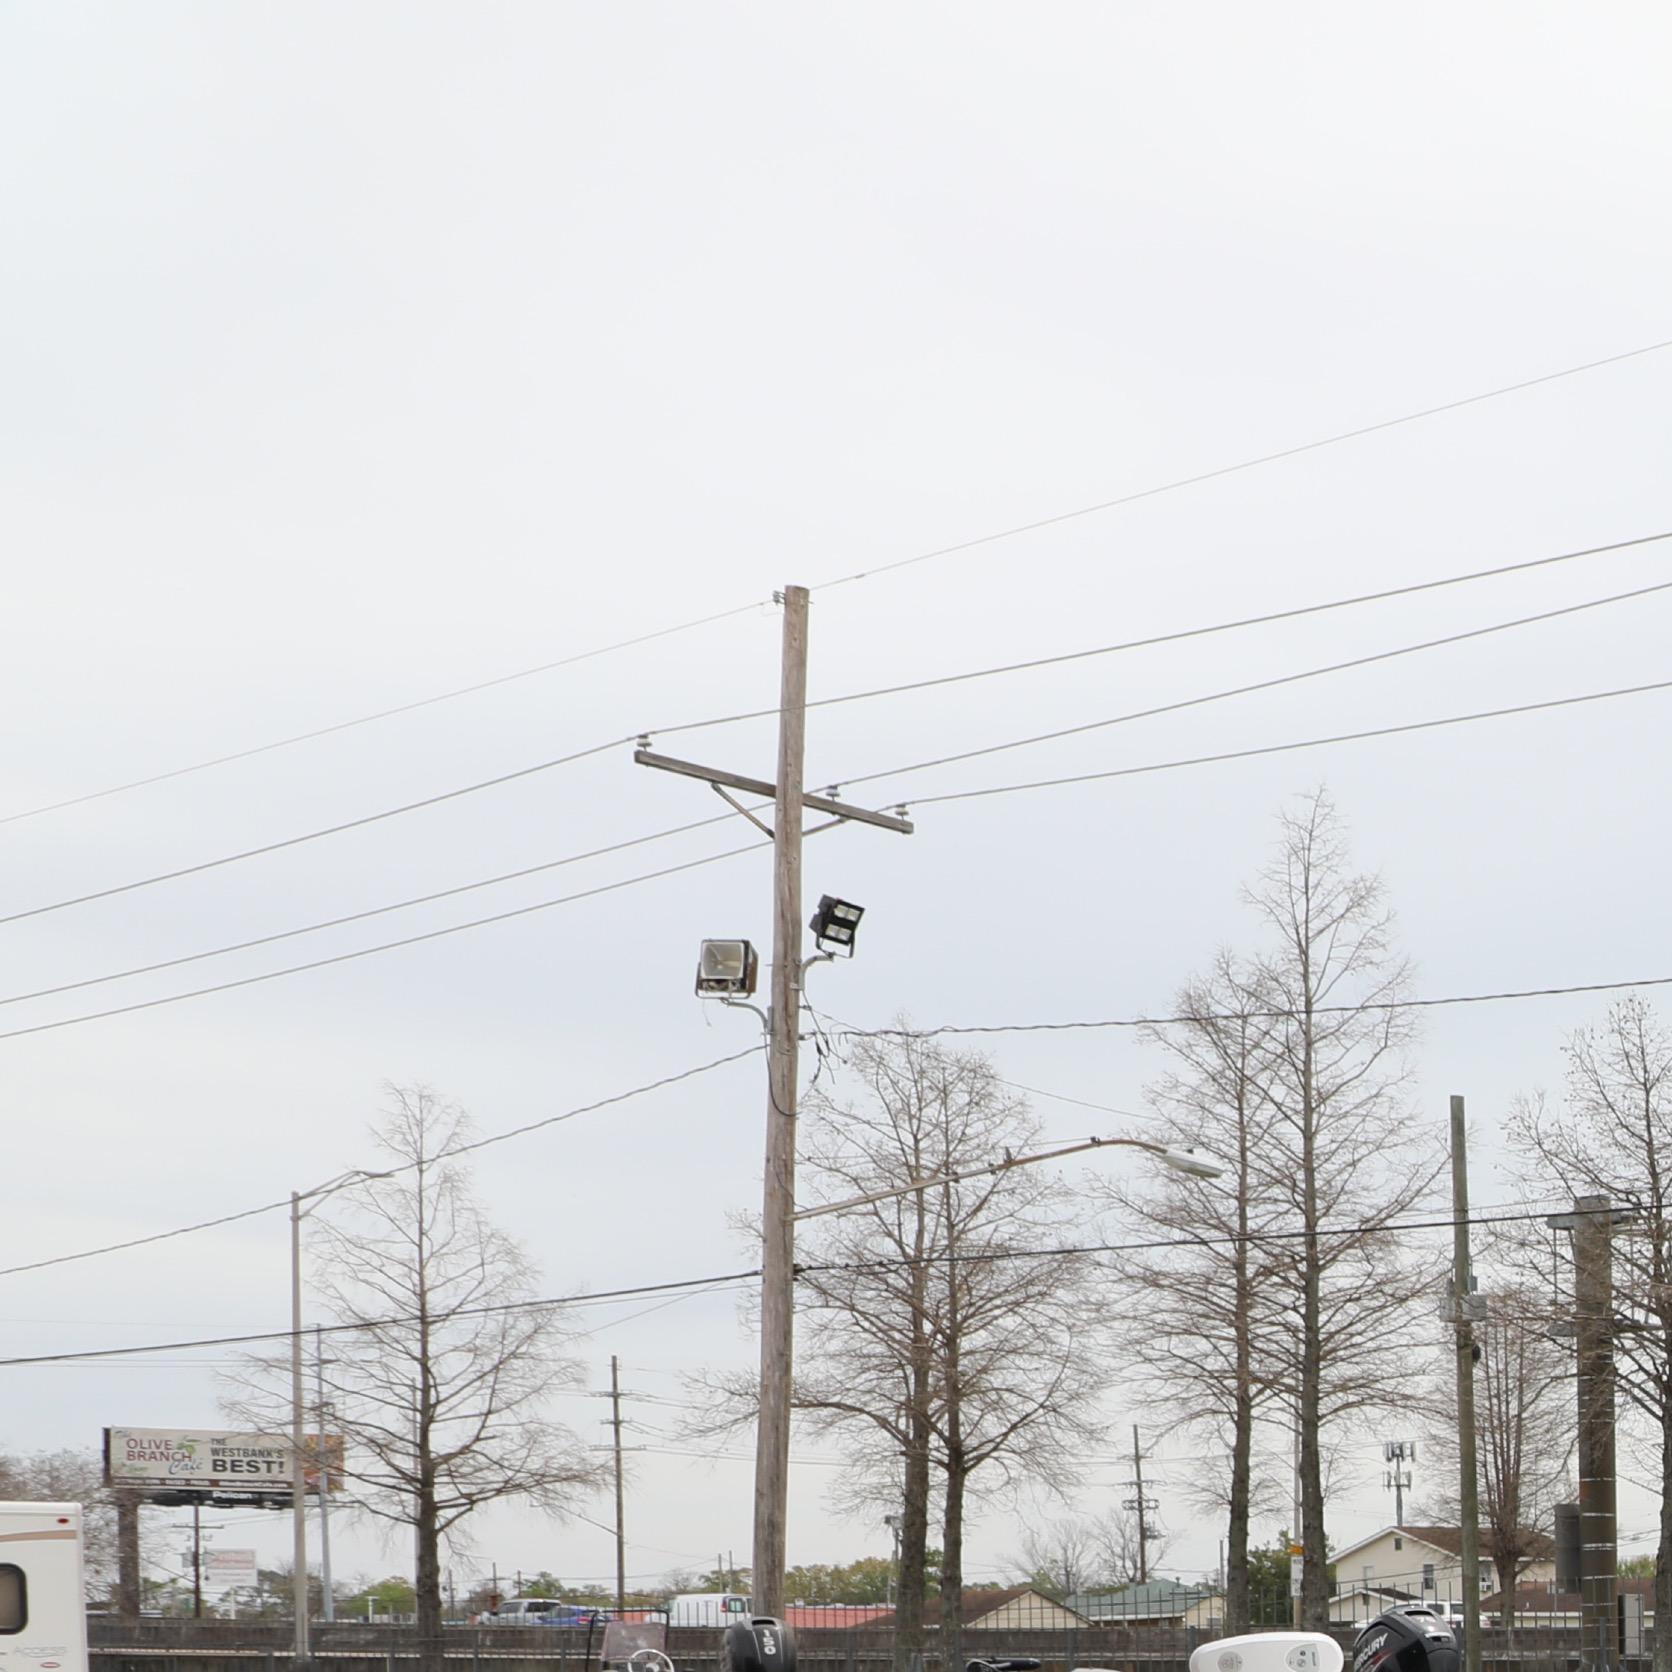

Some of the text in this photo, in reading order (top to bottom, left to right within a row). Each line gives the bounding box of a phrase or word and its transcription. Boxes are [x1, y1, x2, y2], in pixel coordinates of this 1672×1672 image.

[126, 1438, 173, 1450] OLIVE
[211, 1438, 227, 1446] THE
[126, 1450, 192, 1462] BRANCH
[211, 1447, 284, 1459] WESTBANK'S
[212, 1459, 285, 1474] BEST!
[763, 1629, 777, 1655] 150
